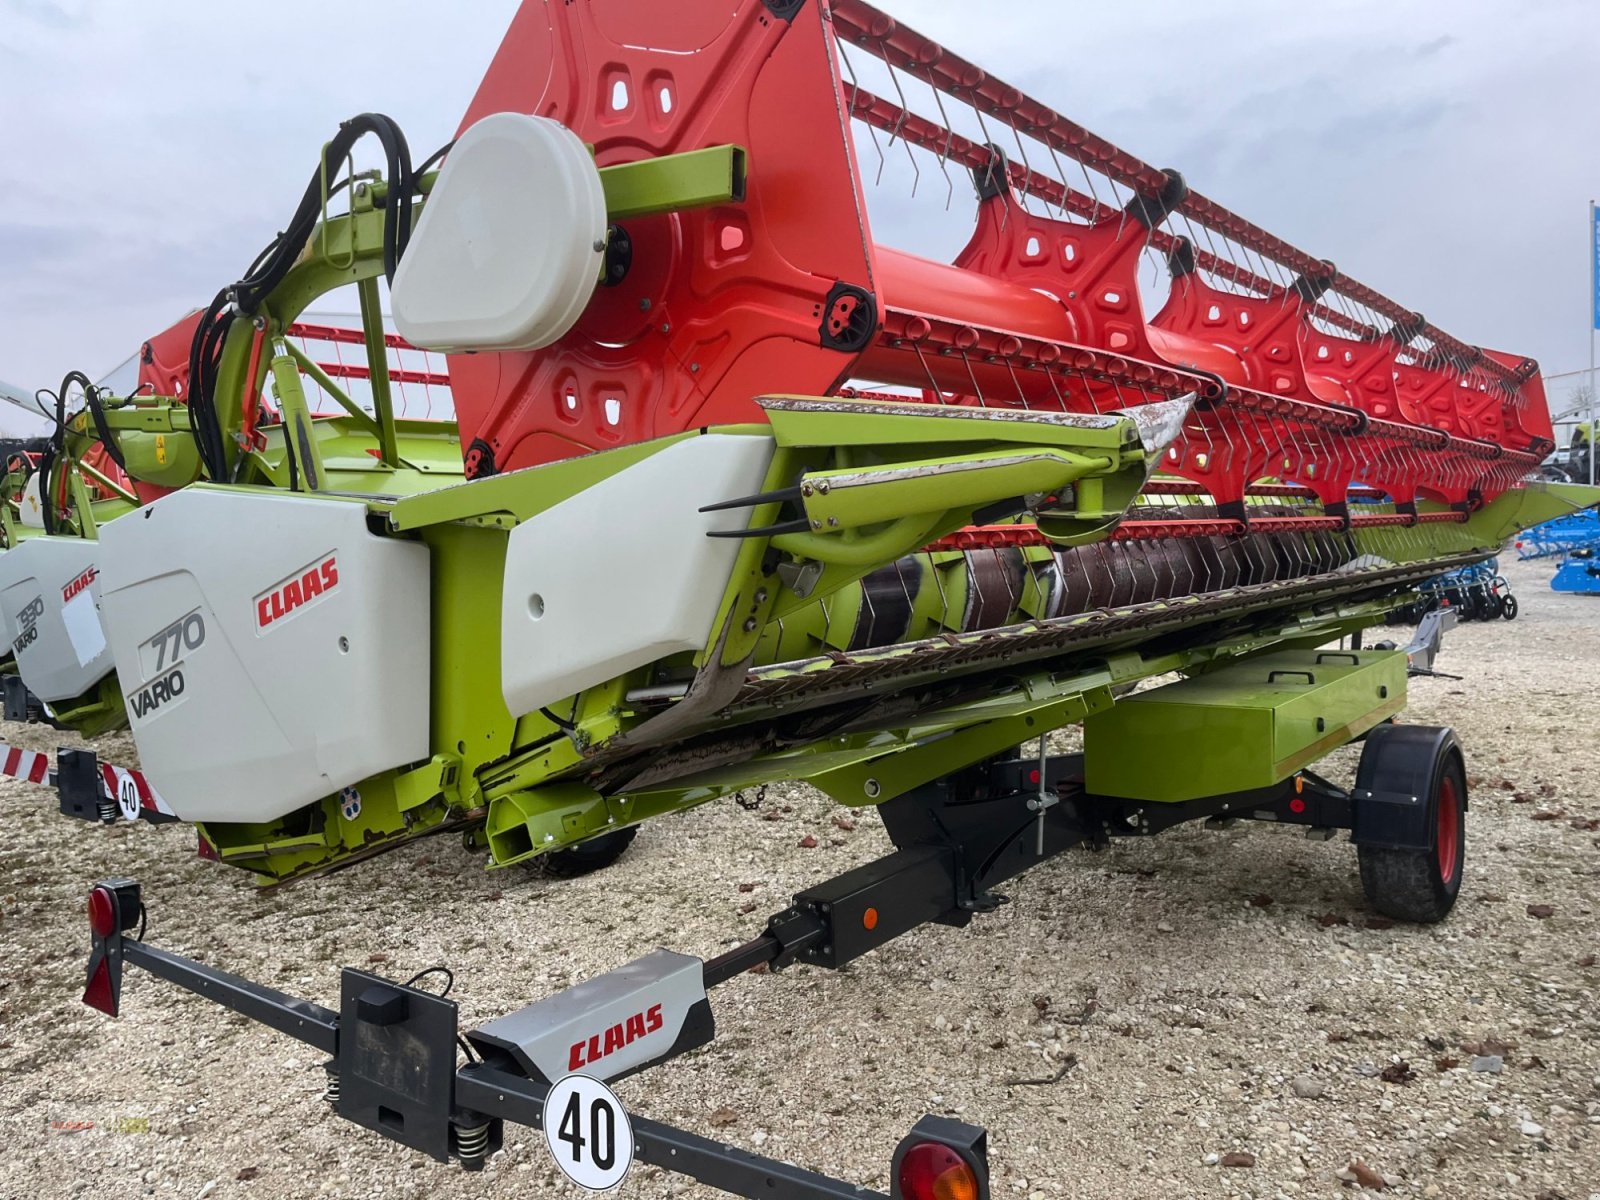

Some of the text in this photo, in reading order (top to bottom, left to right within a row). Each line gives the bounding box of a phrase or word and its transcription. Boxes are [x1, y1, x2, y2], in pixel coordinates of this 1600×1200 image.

[63, 567, 96, 603] CLAAS
[257, 556, 339, 628] CLAAS
[20, 597, 45, 630] 930
[14, 626, 38, 654] VARIO
[150, 612, 206, 673] 770
[130, 669, 185, 719] VARIO
[121, 779, 137, 813] 40
[568, 1003, 664, 1072] CLAAS
[558, 1091, 616, 1171] 40
